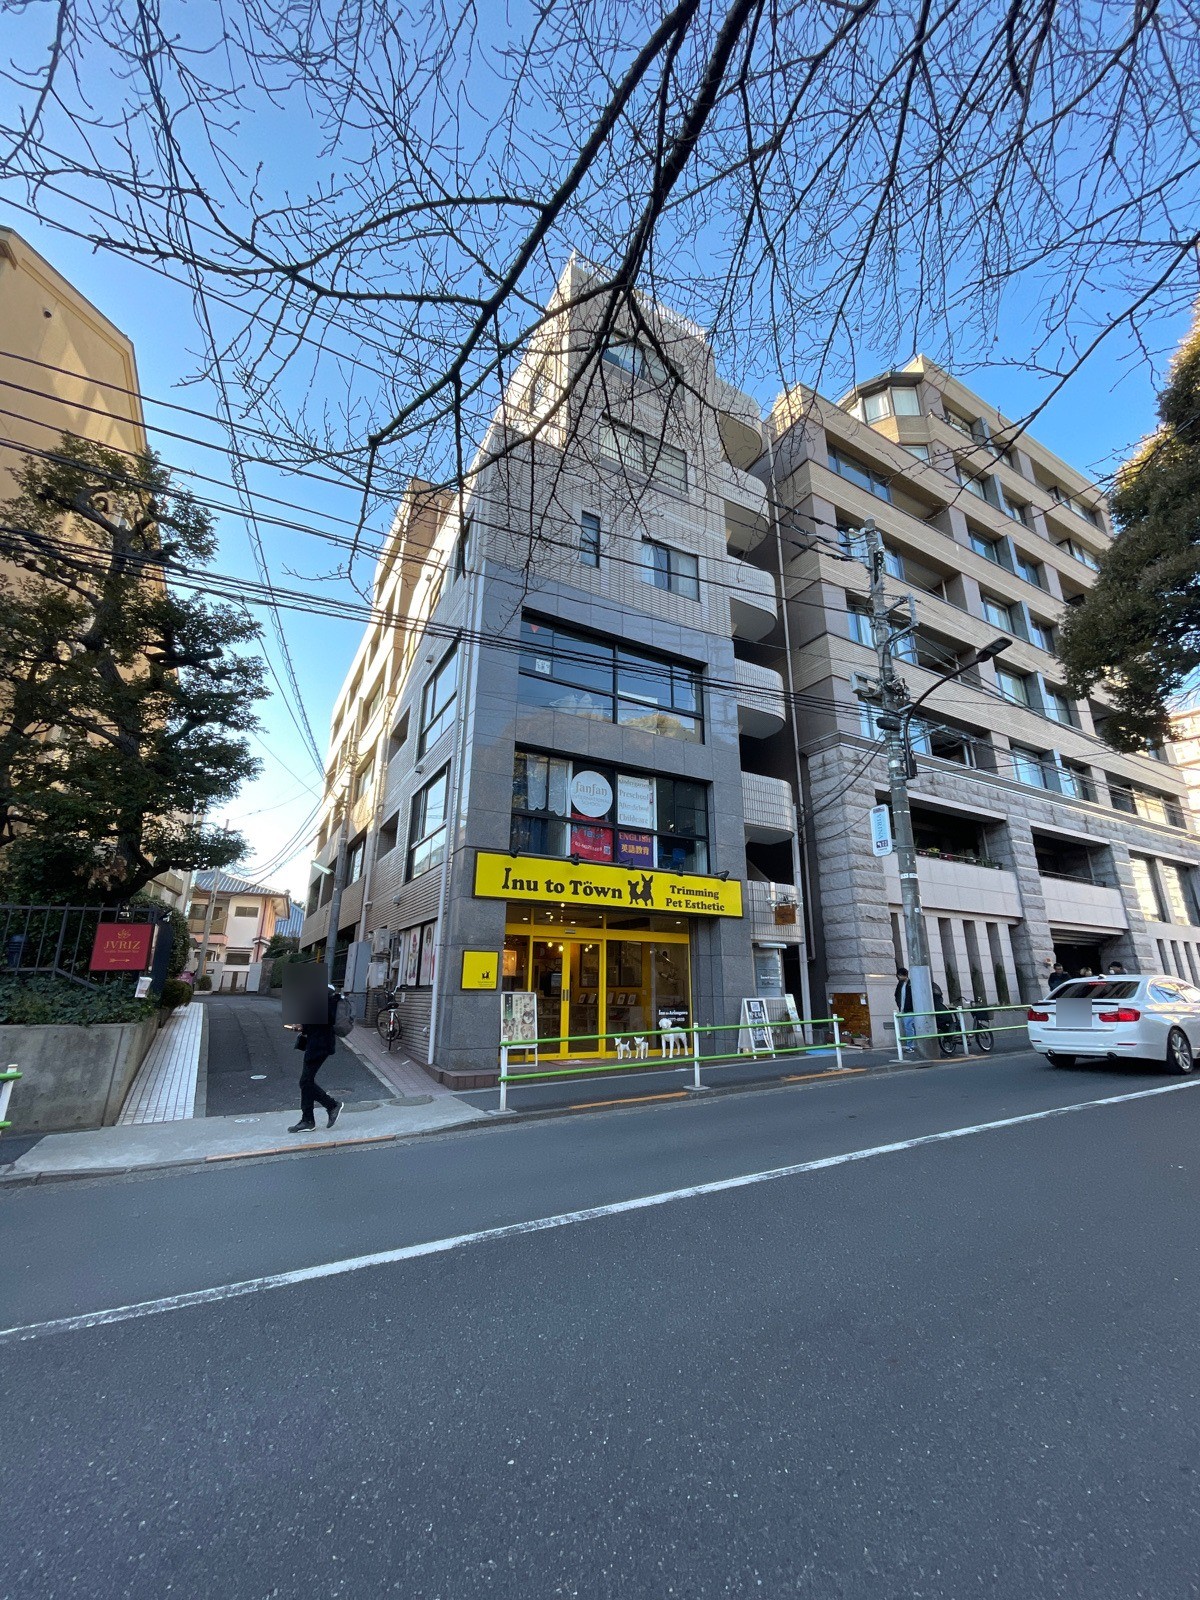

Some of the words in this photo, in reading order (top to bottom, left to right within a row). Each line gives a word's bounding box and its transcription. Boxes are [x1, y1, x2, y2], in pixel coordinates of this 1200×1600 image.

[620, 789, 649, 800] Preschool
[620, 814, 648, 824] Childcare
[619, 832, 651, 843] ENGLISH
[621, 844, 649, 855] 英語教育
[502, 867, 539, 892] Inu
[545, 879, 565, 894] to
[669, 885, 720, 900] Trimming
[665, 897, 683, 909] Pet
[685, 899, 725, 911] Esthetic
